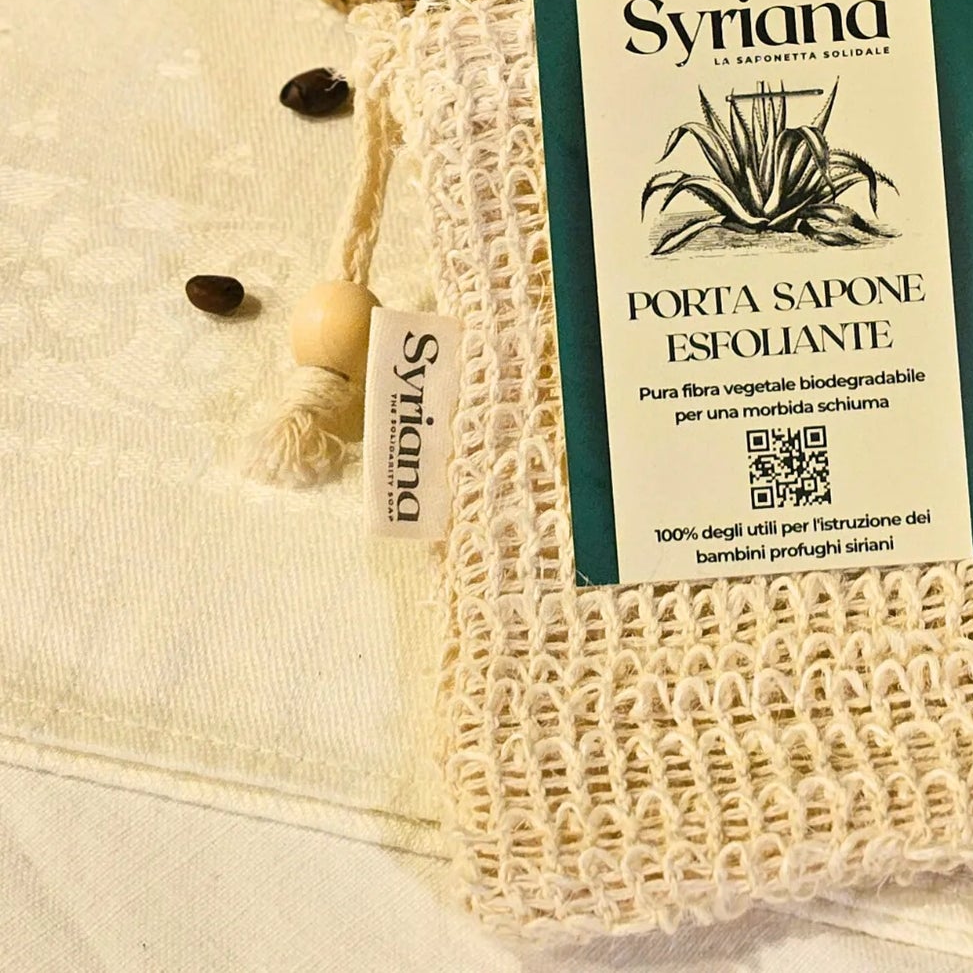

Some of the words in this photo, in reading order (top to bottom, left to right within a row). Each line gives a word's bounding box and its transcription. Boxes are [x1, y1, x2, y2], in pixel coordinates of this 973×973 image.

[713, 57, 730, 66] LA
[736, 51, 818, 65] SAPONETTA
[823, 45, 891, 59] SOLIDALE
[626, 284, 760, 321] PORTA
[773, 273, 927, 312] SAPONE
[665, 319, 894, 364] ESFOLIANTE
[639, 383, 679, 402] Pura
[681, 380, 721, 399] fibra
[723, 376, 797, 399] vegetale
[799, 369, 926, 393] biodegradabile
[393, 331, 440, 522] Syriana
[674, 405, 702, 426] per
[706, 407, 739, 421] una
[742, 398, 814, 419] morbida
[817, 394, 889, 414] schiuma
[387, 418, 397, 487] SOLIDARITY
[386, 491, 395, 522] SOAP
[654, 525, 699, 543] 100%
[701, 522, 744, 544] degli
[747, 520, 778, 537] utili
[781, 519, 810, 539] per
[812, 511, 902, 533] l'istruzione
[905, 509, 931, 526] dei
[696, 545, 767, 565] bambini
[769, 539, 842, 562] profughi
[845, 535, 894, 554] siriani
